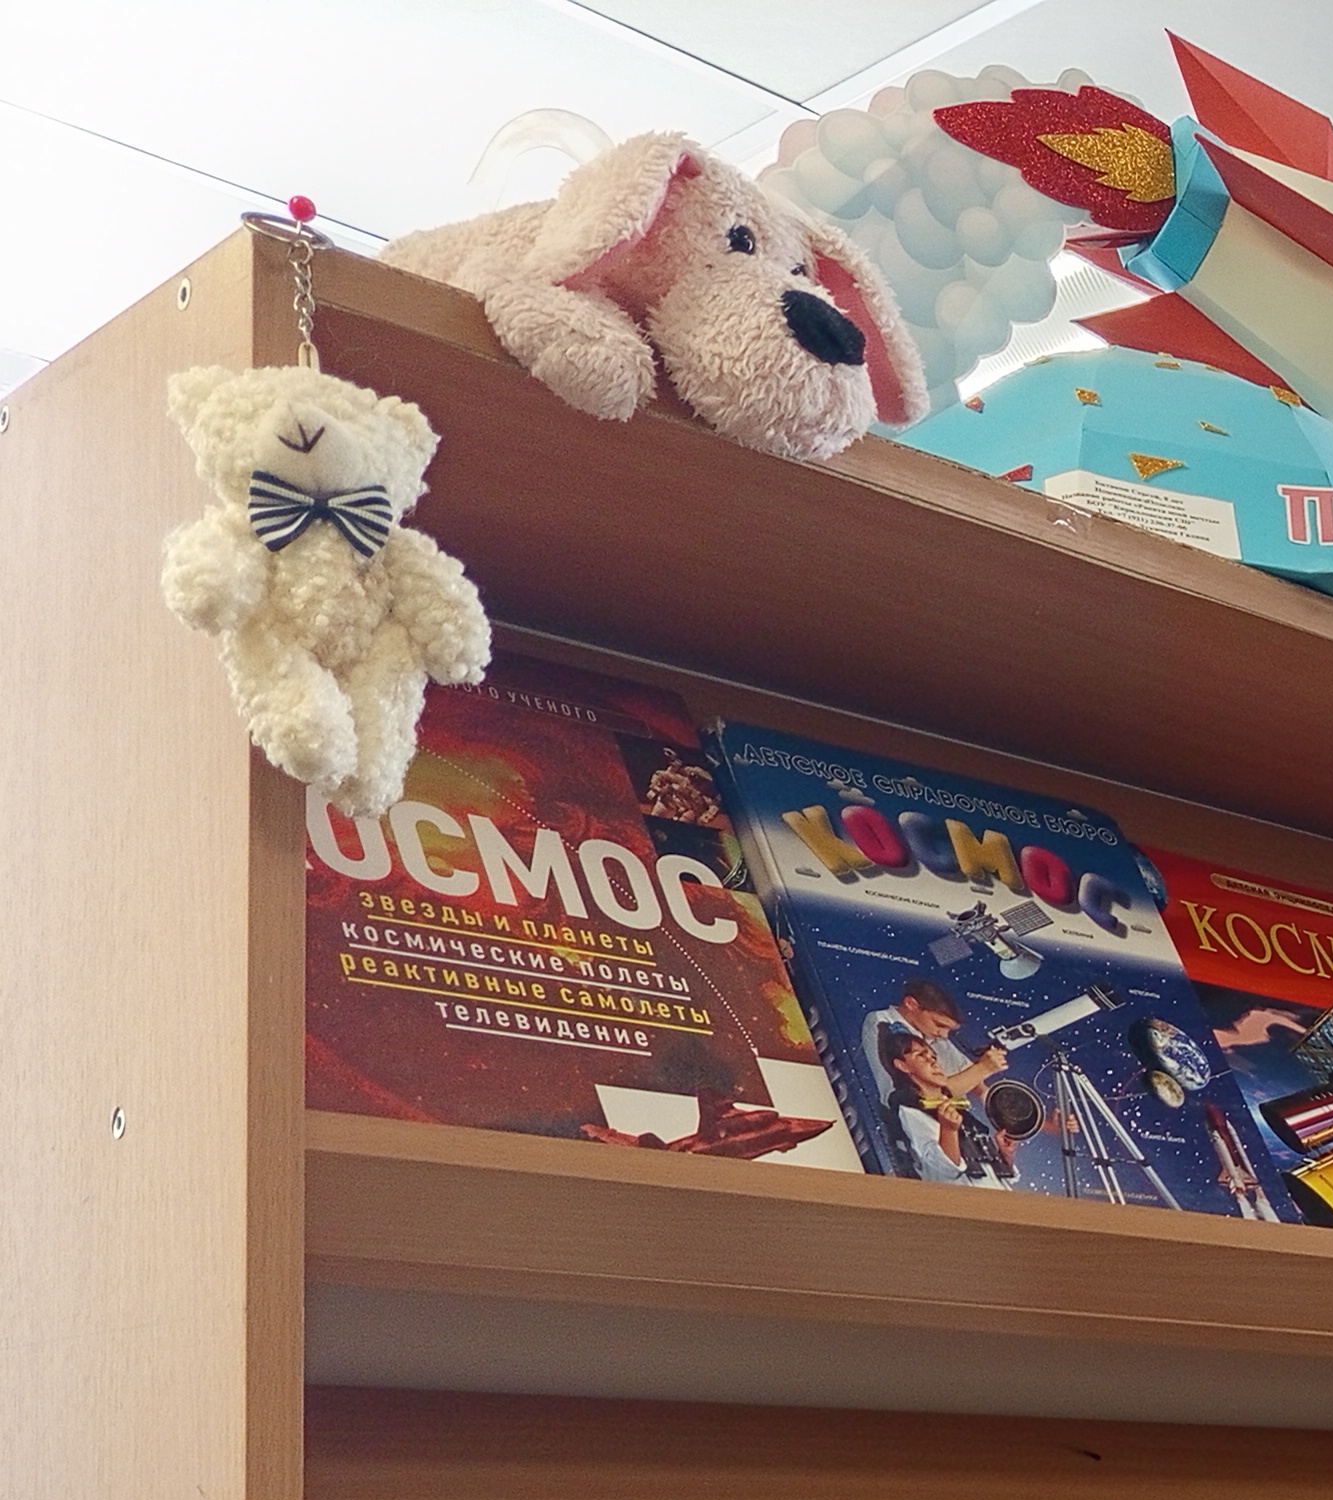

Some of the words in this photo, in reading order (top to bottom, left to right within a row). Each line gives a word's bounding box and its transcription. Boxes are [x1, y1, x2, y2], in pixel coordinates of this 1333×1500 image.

[507, 690, 597, 723] УЧЕНОГО
[744, 743, 868, 789] ДЕТСКОЕ
[872, 773, 1041, 829] СПРАВОЧНОЕ
[1045, 813, 1119, 846] БЮРО
[306, 786, 738, 944] ОСМОС
[781, 804, 1131, 932] КОСМОС
[342, 922, 564, 973] космические
[580, 958, 691, 994] полеты
[359, 892, 483, 927] звезды
[494, 914, 511, 933] и
[522, 919, 654, 957] планеты
[339, 952, 547, 1000] реактивные
[560, 985, 712, 1026] самолеты
[435, 1001, 650, 1047] телевидение
